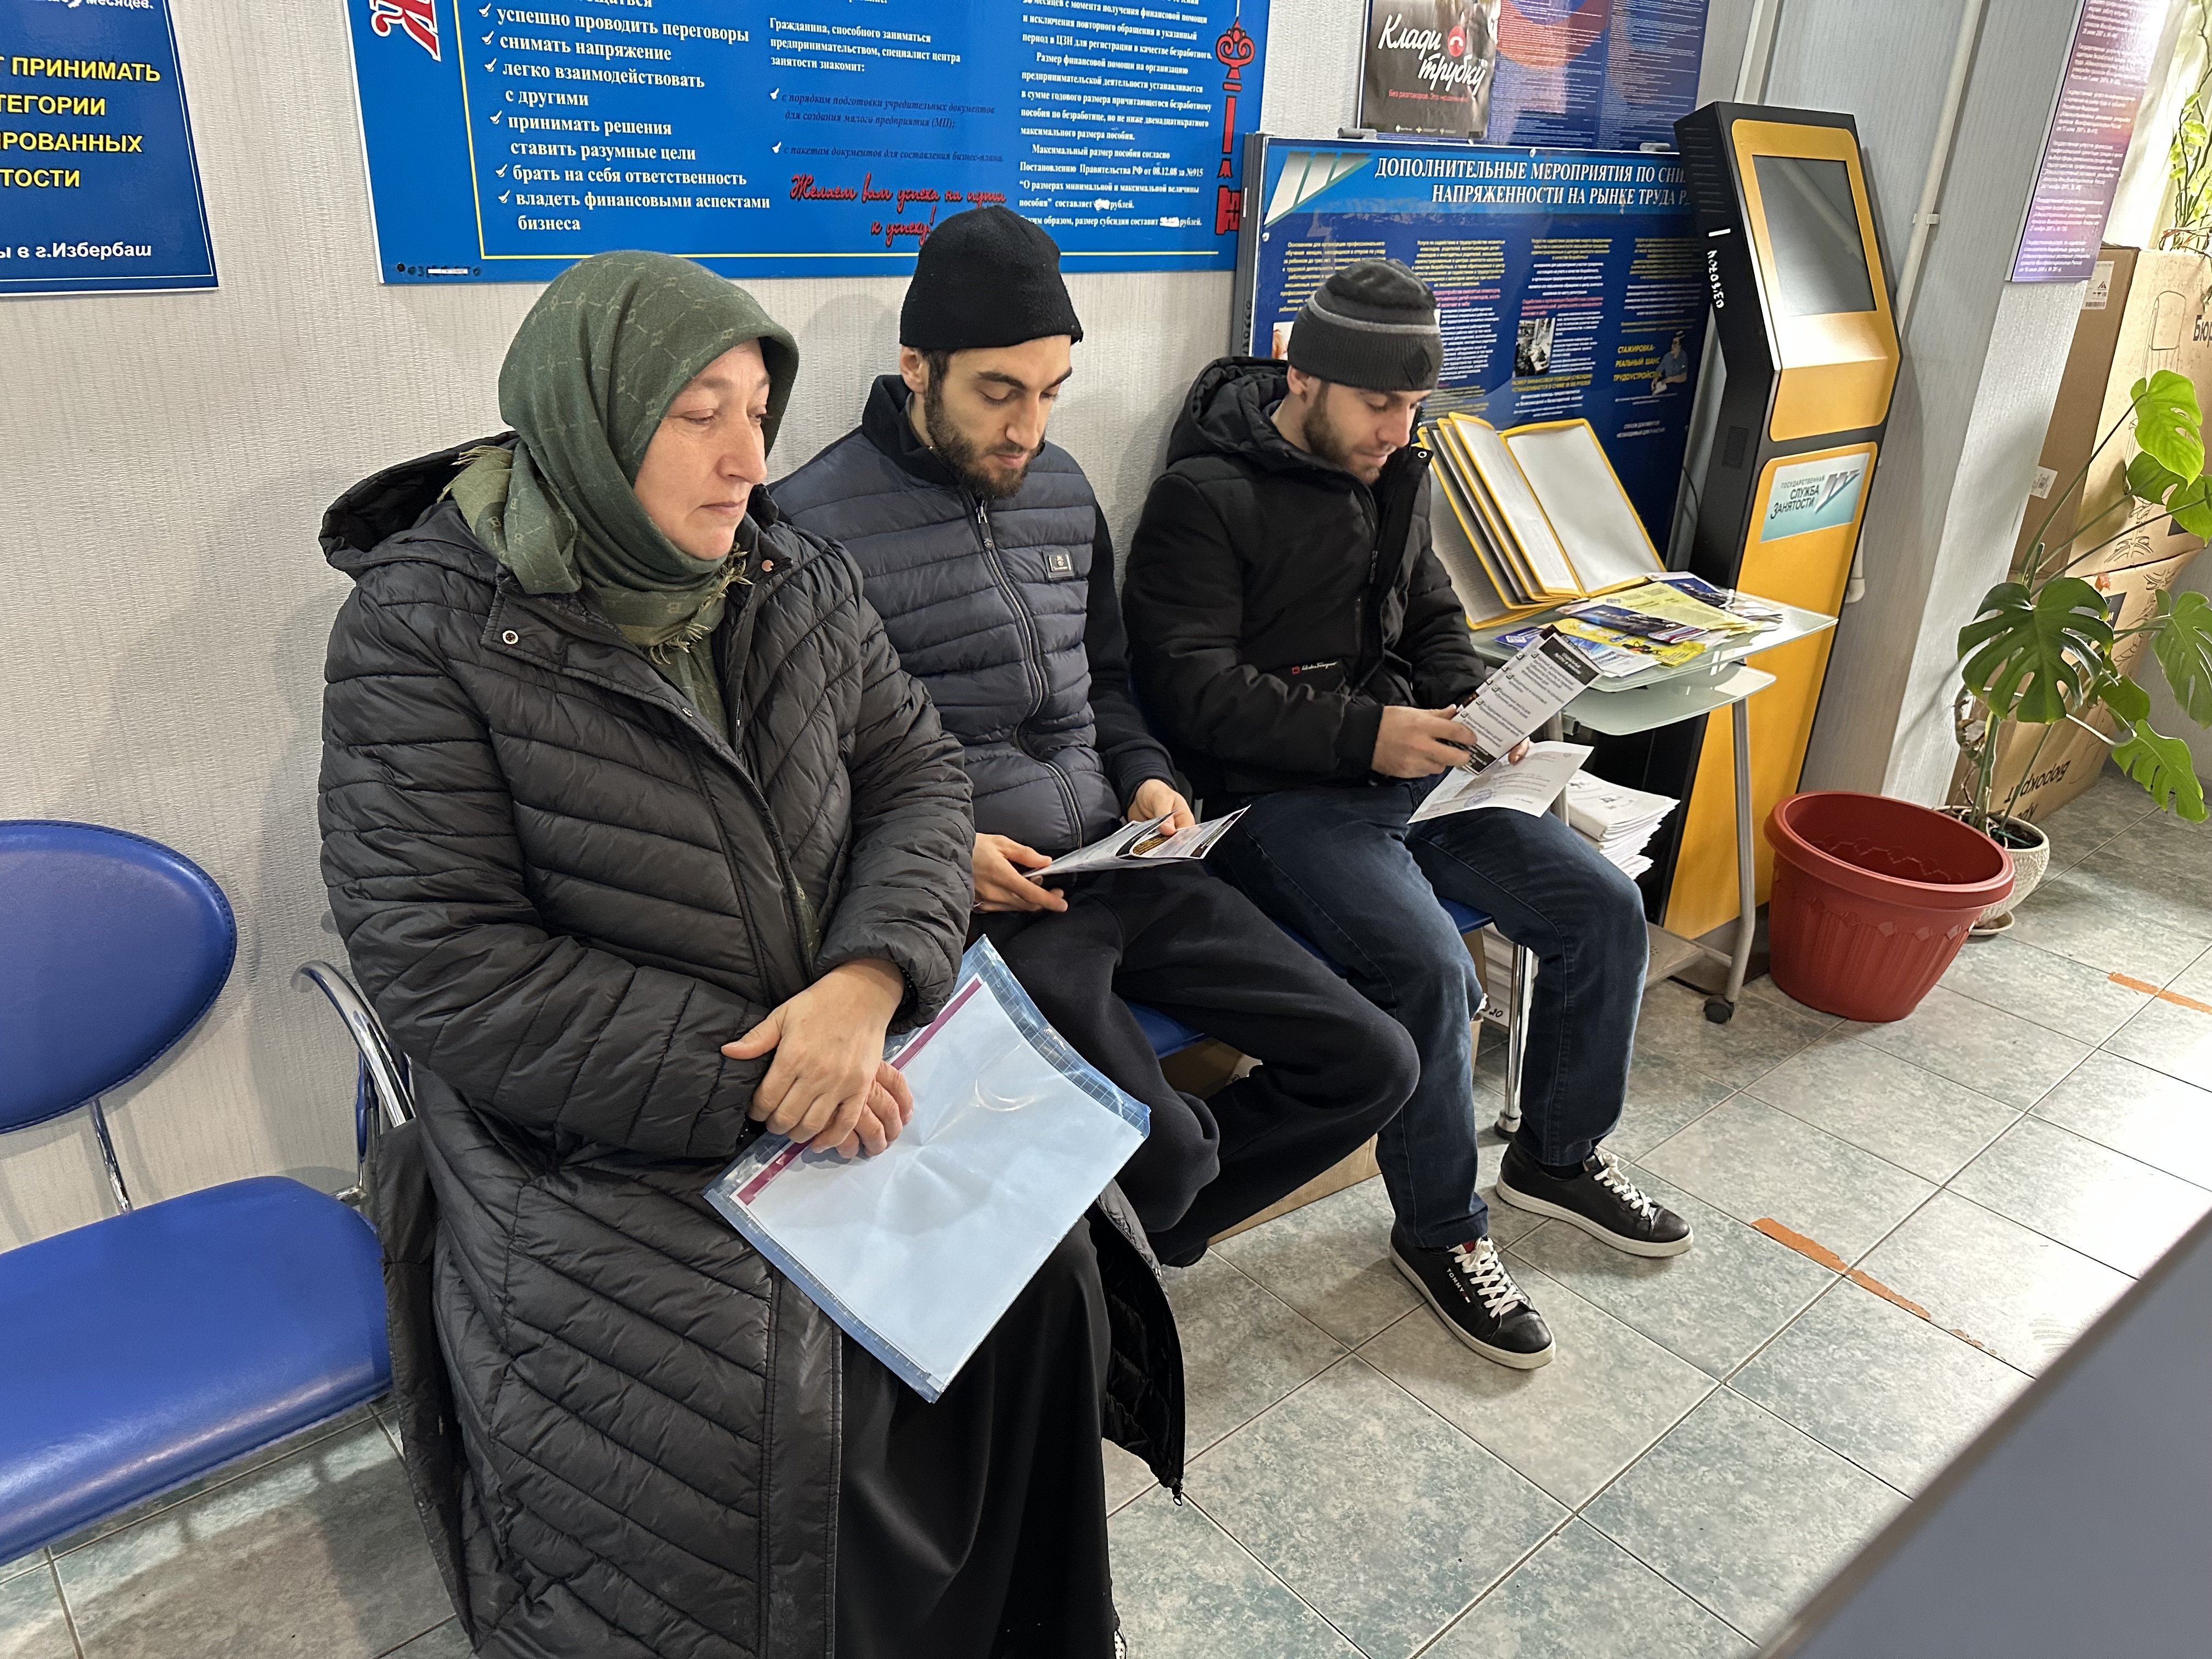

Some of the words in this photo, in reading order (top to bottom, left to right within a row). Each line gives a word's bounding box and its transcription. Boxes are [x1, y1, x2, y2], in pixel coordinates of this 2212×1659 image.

[1070, 1, 1101, 12] момента
[1102, 4, 1139, 16] получения
[1140, 7, 1180, 21] финансовой
[1181, 14, 1207, 24] помощи
[496, 8, 570, 26] успешно
[574, 15, 658, 34] проводить
[662, 23, 749, 44] переговоры
[769, 17, 830, 35] Гражданина,
[831, 25, 881, 38] способного
[882, 30, 931, 43] заниматься
[1022, 14, 1028, 22] и
[1029, 15, 1075, 27] исключения
[1076, 20, 1116, 32] повторного
[1116, 22, 1155, 36] обращения
[1161, 30, 1197, 41] указанный
[1378, 13, 1442, 60] Клади
[499, 36, 571, 53] снимать
[575, 42, 672, 61] напряжение
[770, 38, 880, 57] предпринимательством,
[881, 48, 930, 60] специалист
[932, 52, 960, 65] центра
[1022, 33, 1048, 44] период
[1056, 34, 1073, 46] ЦЗН
[1073, 39, 1087, 47] для
[1088, 40, 1133, 52] регистрации
[1139, 45, 1169, 55] качестве
[1169, 46, 1213, 59] безработного.
[12, 57, 160, 81] ПРИНИМАТЬ
[770, 57, 817, 68] занятости
[819, 60, 865, 72] знакомит:
[1035, 51, 1062, 66] Размер
[1063, 54, 1106, 67] финансовой
[1107, 60, 1135, 70] помощи
[1145, 64, 1189, 75] организацию
[502, 63, 550, 78] легко
[554, 66, 705, 88] взаимодействовать
[1021, 71, 1102, 85] предпринимательской
[1102, 78, 1149, 89] деятельности
[1417, 53, 1486, 96] трубку
[505, 89, 514, 102] с
[517, 91, 589, 108] другими
[781, 93, 786, 102] с
[788, 93, 831, 105] порядком
[832, 95, 882, 108] подготовки
[883, 99, 947, 111] учредительных
[948, 103, 995, 115] документов
[1027, 91, 1050, 101] сумме
[1051, 92, 1082, 101] годового
[1082, 94, 1111, 106] размера
[1111, 97, 1169, 108] причитающегося
[1169, 98, 1212, 113] безработному
[784, 110, 801, 120] для
[802, 111, 841, 121] создания
[843, 115, 873, 123] малого
[875, 115, 929, 128] предприятия
[1020, 107, 1050, 118] пособия
[1051, 110, 1061, 119] по
[1061, 109, 1106, 122] безработице,
[1125, 115, 1144, 123] ниже
[508, 116, 600, 133] принимать
[603, 121, 672, 137] решения
[1020, 127, 1076, 137] максимального
[1077, 130, 1105, 141] размера
[1106, 130, 1135, 140] пособия.
[0, 131, 143, 153] РОВАННЫХ
[510, 142, 577, 156] ставить
[580, 145, 656, 161] разумные
[660, 148, 696, 161] цели
[1032, 143, 1088, 155] Максимальный
[1089, 148, 1113, 159] размер
[1113, 148, 1141, 158] пособия
[1141, 151, 1170, 159] согласно
[790, 146, 829, 155] пакетом
[831, 146, 882, 159] документов
[883, 149, 898, 159] для
[899, 151, 950, 160] составления
[0, 168, 80, 187] ТОСТИ
[513, 165, 560, 184] брать
[564, 170, 584, 182] на
[587, 167, 621, 182] себя
[624, 171, 747, 185] ответственность
[1019, 161, 1077, 173] Постановлению
[1079, 163, 1131, 176] Правительства
[1132, 165, 1143, 175] РФ
[1374, 157, 1528, 179] ДОПОЛНИТЕЛЬНЫЕ
[1529, 162, 1633, 182] МЕРОПРИЯТИЯ
[1635, 166, 1655, 183] ПО
[790, 173, 857, 200] Желаем
[862, 173, 893, 201] вам
[897, 190, 939, 213] успеха
[945, 191, 963, 202] на
[1031, 182, 1063, 192] размерах
[1065, 182, 1112, 191] минимальной
[1119, 184, 1167, 193] максимальной
[1432, 185, 1563, 204] НАПРЯЖЕННОСТИ
[1567, 187, 1585, 204] НА
[1589, 188, 1635, 205] РЫНКЕ
[1638, 188, 1674, 206] ТРУДА
[515, 194, 581, 207] владеть
[584, 191, 691, 210] финансовыми
[695, 196, 770, 208] аспектами
[1054, 200, 1092, 208] составляет
[1109, 199, 1134, 211] рублей.
[517, 215, 581, 230] бизнеса
[871, 222, 882, 234] к
[1043, 215, 1074, 227] образом,
[1074, 217, 1099, 227] размер
[1099, 216, 1129, 227] субсидии
[1179, 217, 1202, 228] рублей.
[16, 246, 30, 258] в
[35, 241, 151, 261] г.Избербаш
[1790, 484, 1820, 500] СЛУЖБА
[1770, 496, 1816, 520] ЗАНЯТОСТИ
[2003, 760, 2072, 804] Бюрокрт
[1447, 1268, 1465, 1292] TOMMY
